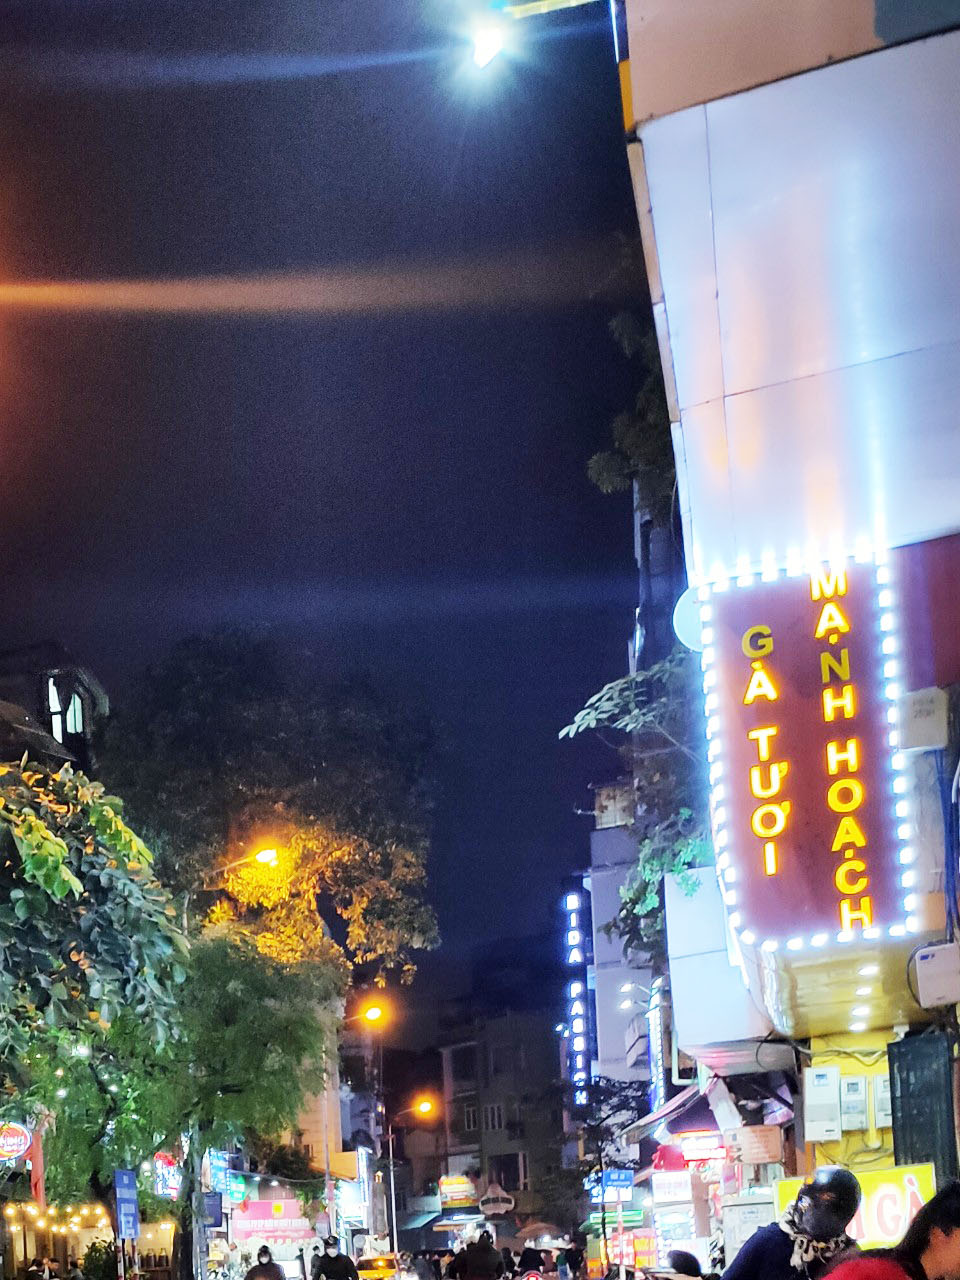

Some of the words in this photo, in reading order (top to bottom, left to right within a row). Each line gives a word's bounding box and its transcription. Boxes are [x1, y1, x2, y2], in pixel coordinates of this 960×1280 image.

[741, 624, 778, 705] GÀ
[809, 563, 855, 722] MẠNH
[748, 725, 790, 876] TƯƠI
[826, 738, 873, 931] HOẠCH
